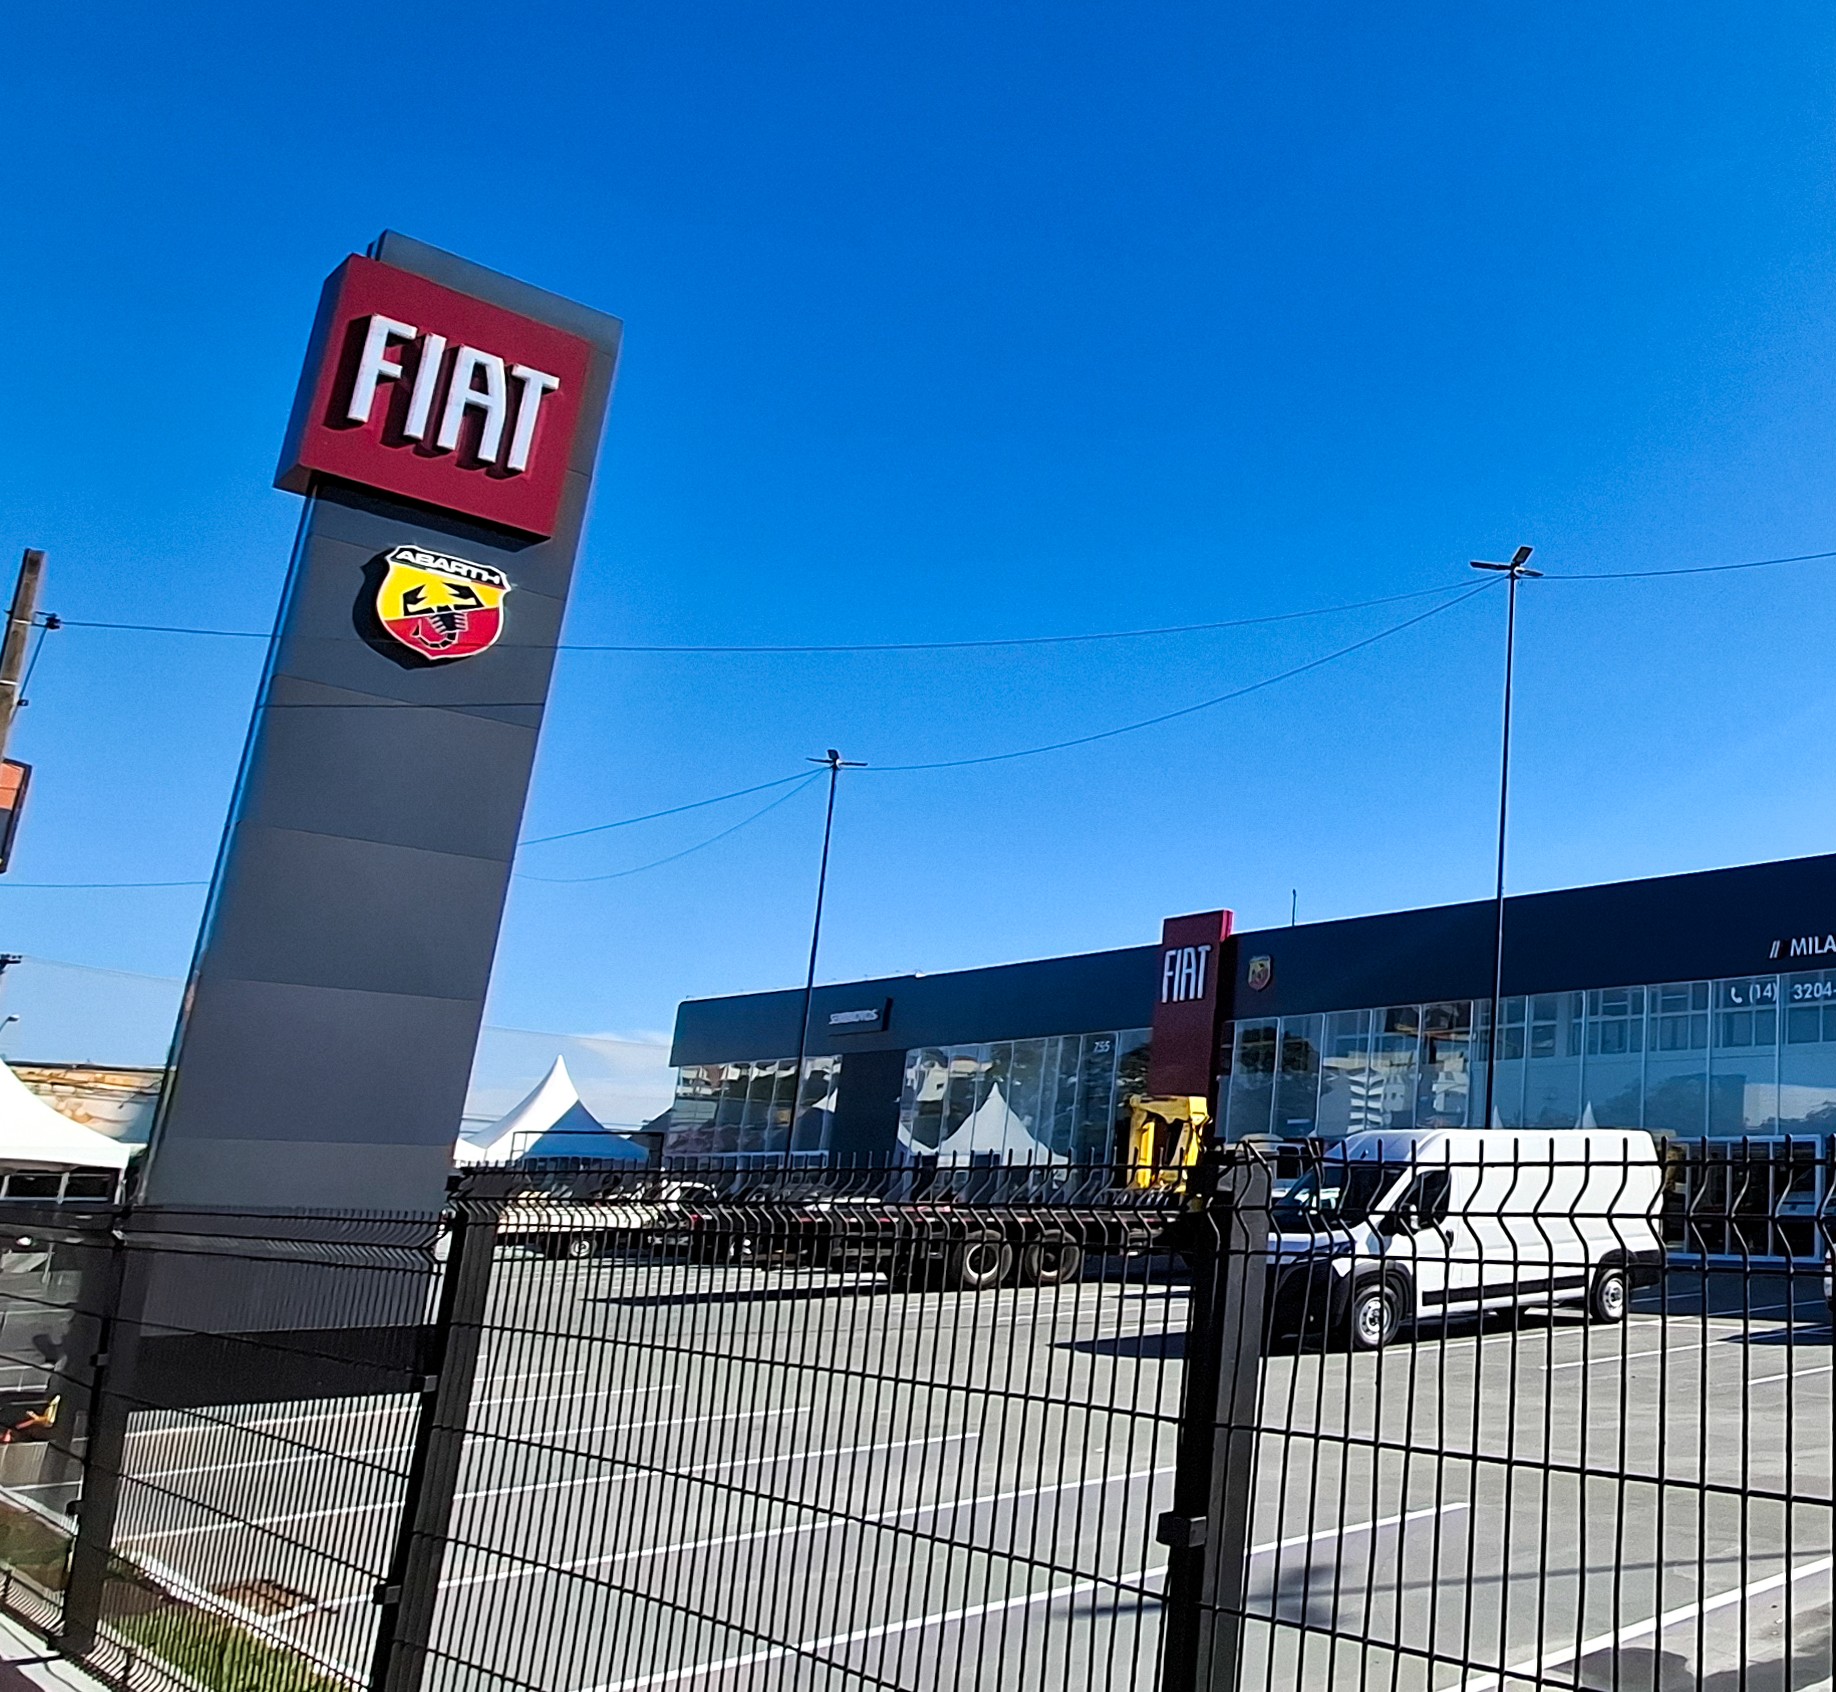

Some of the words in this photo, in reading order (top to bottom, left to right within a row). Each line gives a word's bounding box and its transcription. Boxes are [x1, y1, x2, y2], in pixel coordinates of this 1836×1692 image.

[346, 312, 561, 473] FIAT
[395, 550, 501, 585] ABARTH
[1161, 944, 1212, 1004] FIAT
[1749, 982, 1778, 1003] (14)
